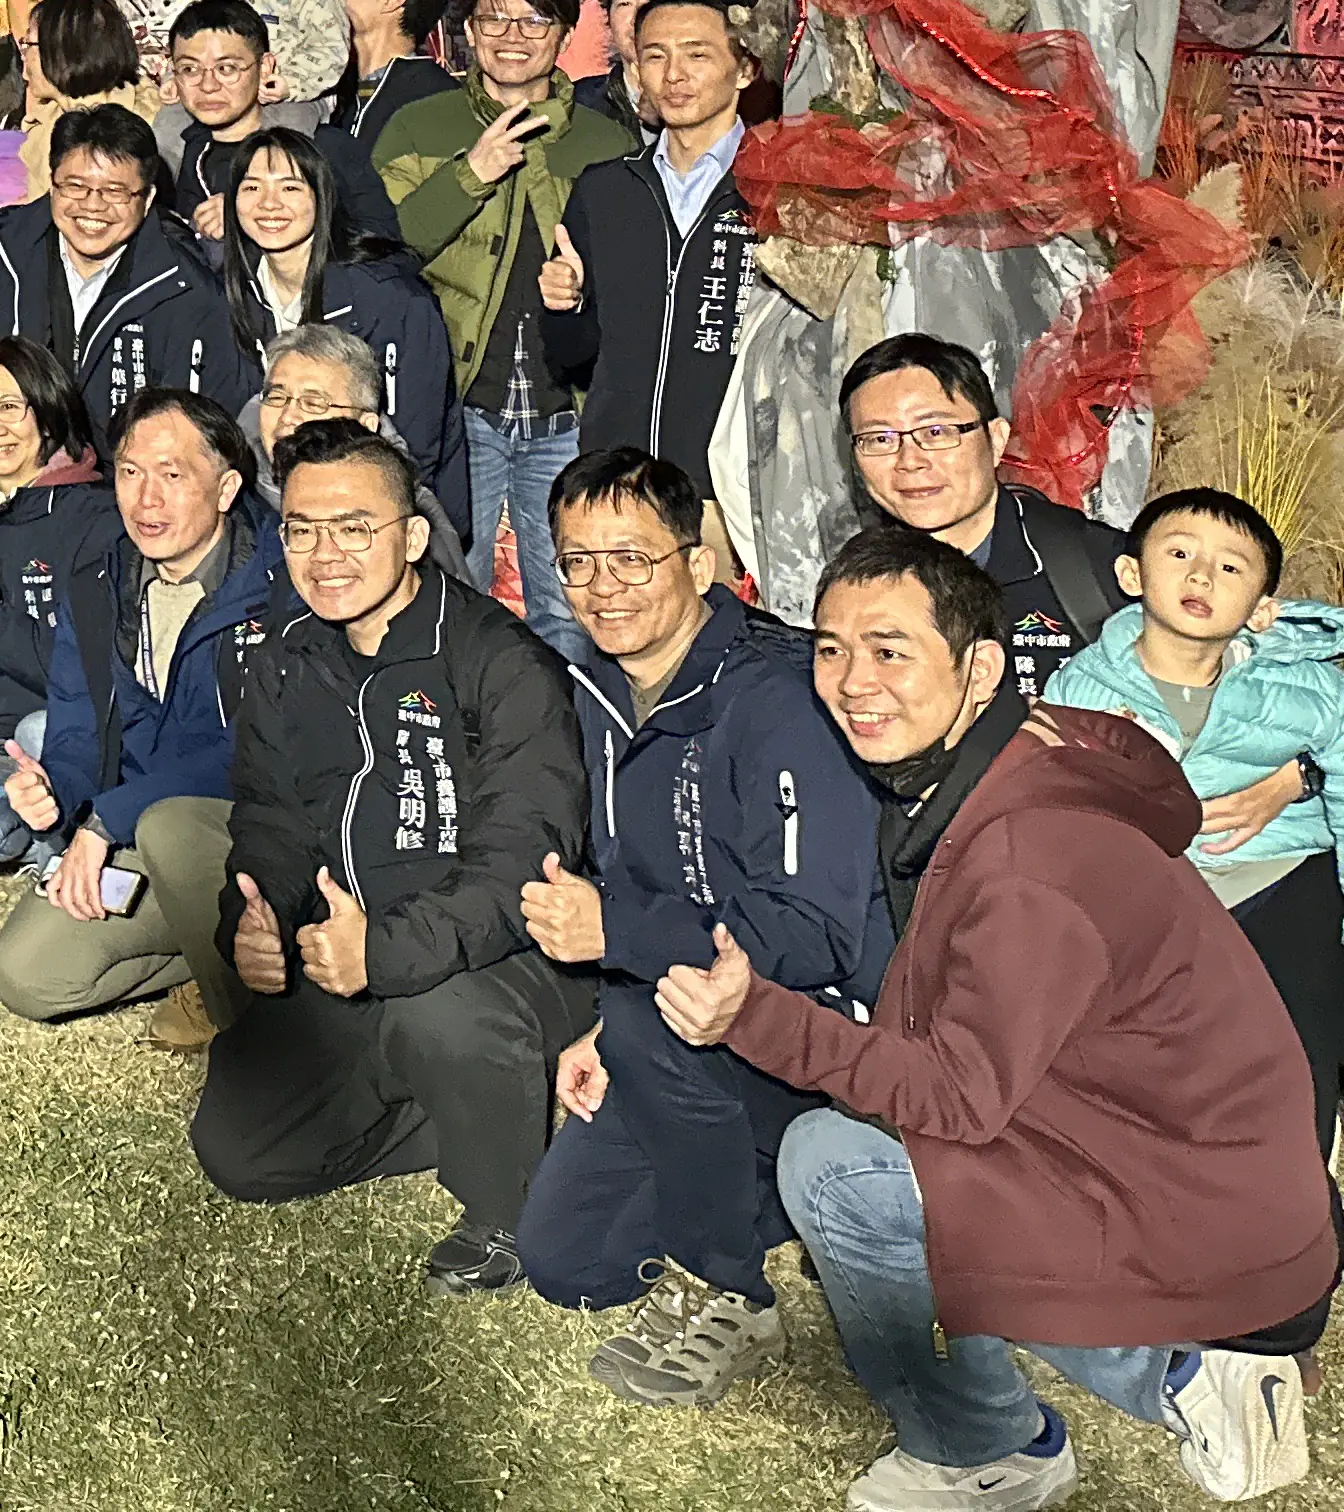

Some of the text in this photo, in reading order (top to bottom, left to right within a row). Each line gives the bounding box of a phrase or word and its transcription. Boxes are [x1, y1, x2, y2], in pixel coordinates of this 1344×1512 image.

[693, 276, 727, 353] 王仁志
[1012, 633, 1072, 648] 臺中市政府
[1014, 655, 1038, 696] 隊長
[395, 769, 426, 851] 吳明修
